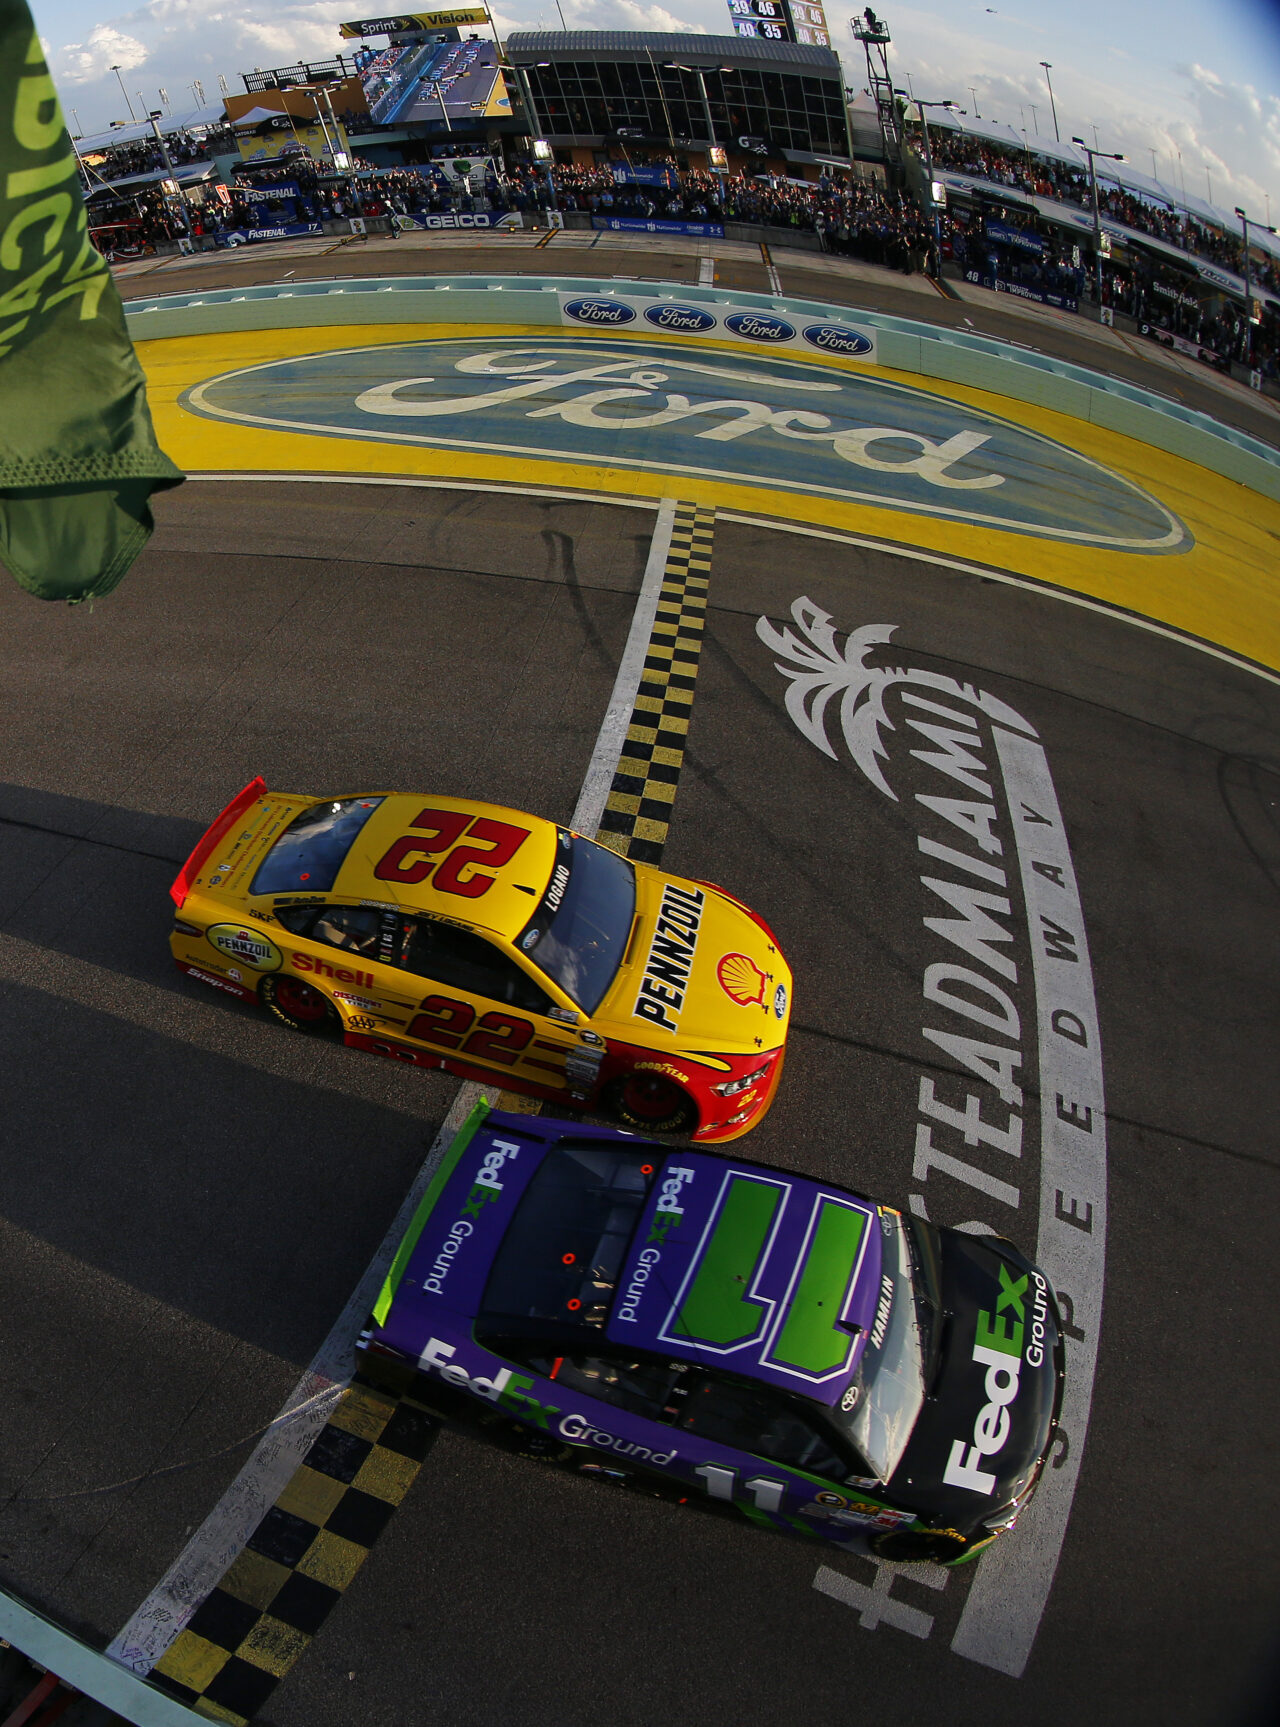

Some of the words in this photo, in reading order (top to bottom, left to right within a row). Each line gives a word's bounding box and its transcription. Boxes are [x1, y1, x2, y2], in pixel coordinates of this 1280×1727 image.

[361, 19, 398, 34] Sprint
[427, 11, 475, 25] Vision
[732, 0, 749, 14] 39
[758, 1, 775, 16] 46
[739, 23, 755, 37] 40
[763, 23, 782, 39] 35
[248, 227, 287, 239] FASTENAL
[308, 223, 318, 231] 17
[426, 214, 490, 229] GEICO
[966, 270, 979, 282] 48
[354, 348, 1005, 489] Ford
[374, 808, 533, 899] 22
[249, 909, 275, 923] SKF
[545, 864, 570, 912] LOGANO
[217, 936, 273, 959] PENNZOIL
[291, 951, 375, 990] Shell
[631, 882, 706, 1036] PENNZOIL
[405, 994, 535, 1067] 22
[634, 1062, 689, 1083] GOODYEAR
[458, 1139, 520, 1220] FedEx
[645, 1166, 696, 1246] FedEx
[422, 1220, 474, 1295] Ground
[617, 1248, 661, 1323] Ground
[657, 1169, 874, 1384] 11
[870, 1274, 895, 1350] HAMLIN
[1025, 1270, 1048, 1369] Ground
[417, 1336, 561, 1430] FedEx
[558, 1414, 678, 1467] Ground
[942, 1262, 1030, 1496] FedEx
[695, 1463, 787, 1513] 11
